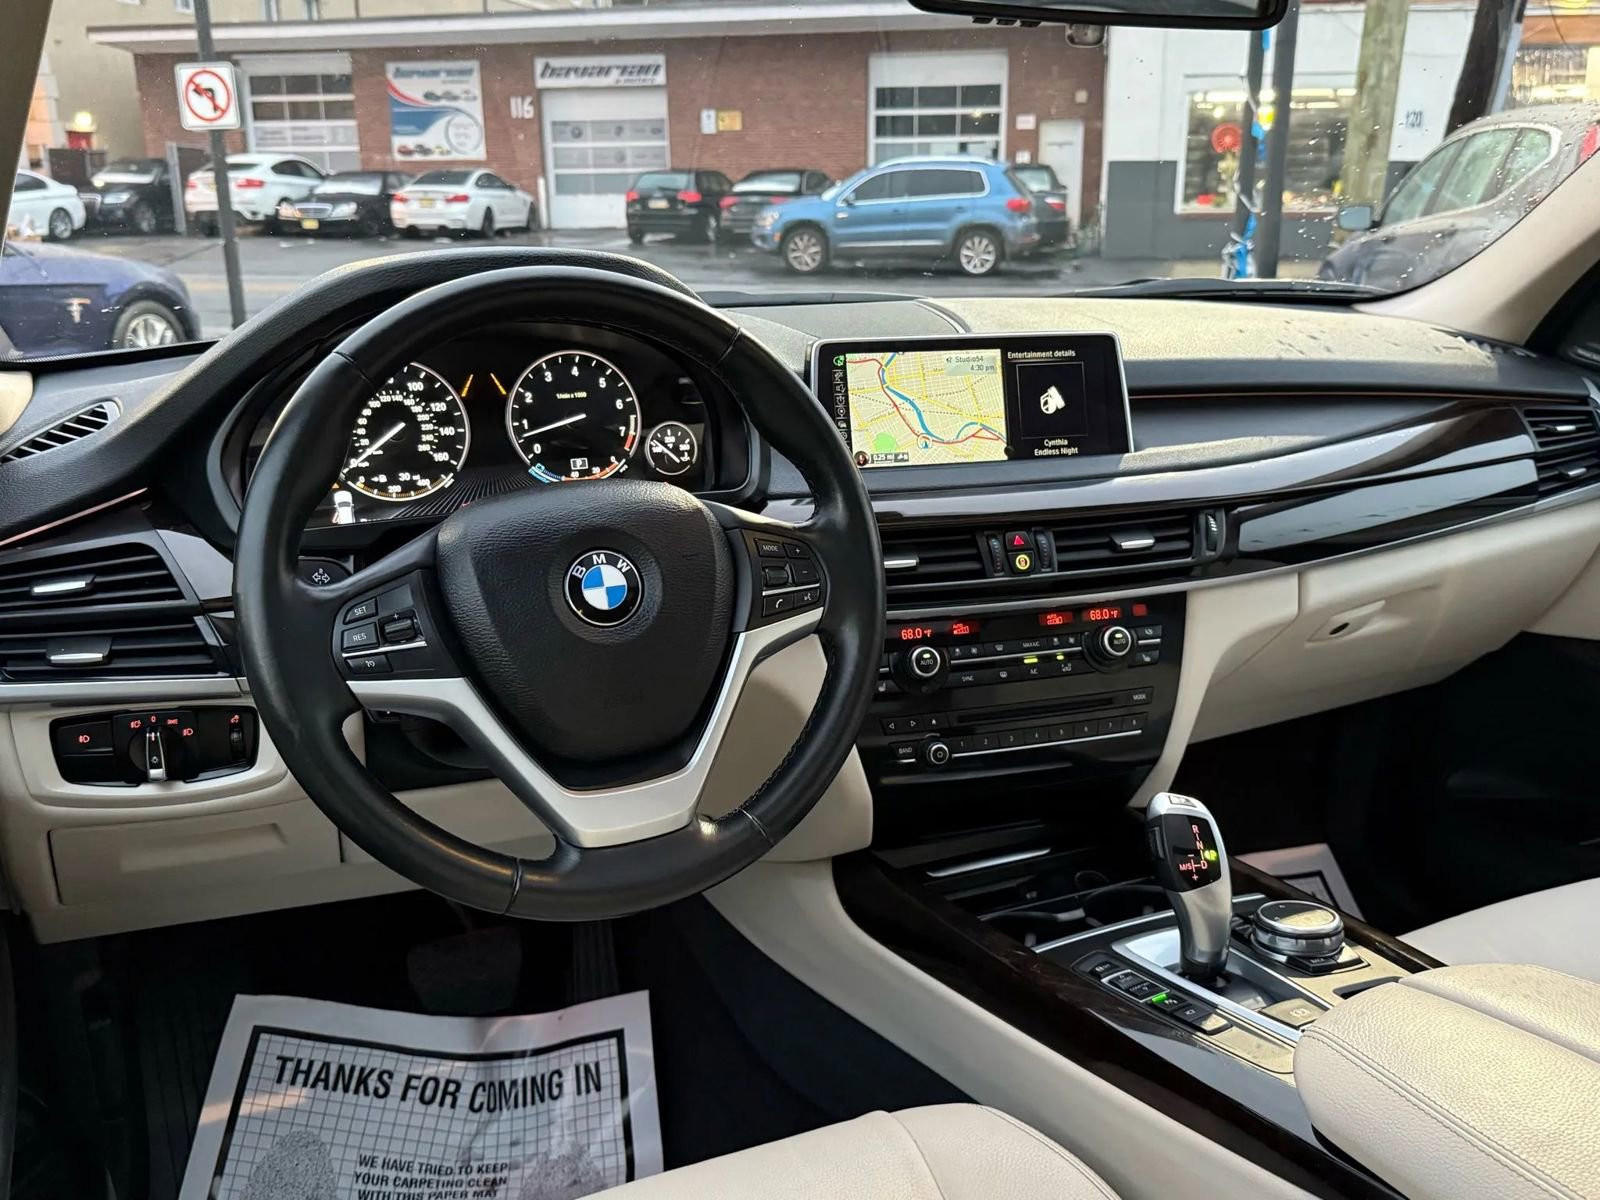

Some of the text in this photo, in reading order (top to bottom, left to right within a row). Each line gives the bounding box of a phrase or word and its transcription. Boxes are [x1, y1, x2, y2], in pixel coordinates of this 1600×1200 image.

[510, 96, 535, 120] 116
[1007, 350, 1076, 359] Entertainment details
[544, 371, 553, 382] 3
[571, 366, 579, 377] 4
[407, 381, 424, 392] 100
[598, 377, 607, 388] 5
[524, 392, 533, 403] 2
[430, 402, 447, 412] 120
[615, 399, 624, 410] 6
[522, 419, 529, 430] 1
[439, 426, 455, 436] 140
[619, 426, 626, 437] 7
[1043, 438, 1068, 447] Cynthia
[533, 443, 542, 454] 0
[1034, 447, 1079, 456] Endless Night
[432, 452, 450, 462] 160
[398, 472, 411, 481] 30
[417, 478, 431, 487] 400
[388, 485, 402, 493] 200
[762, 544, 779, 553] MODE
[572, 553, 632, 579] BMW
[354, 605, 368, 616] SET
[1089, 609, 1110, 620] 68.0
[352, 632, 368, 642] RES
[901, 628, 923, 640] 68.0
[1192, 824, 1200, 834] R
[1196, 841, 1204, 850] N
[1179, 862, 1192, 871] M/S
[1200, 860, 1208, 870] D
[275, 1055, 602, 1113] THANKS FOR COMING IN
[359, 1154, 509, 1177] WE HAVE TRIED TO KEEP
[354, 1171, 508, 1189] YOUR CARPETING CLEAN
[358, 1189, 499, 1200] WITH THIS PAPER MAT
